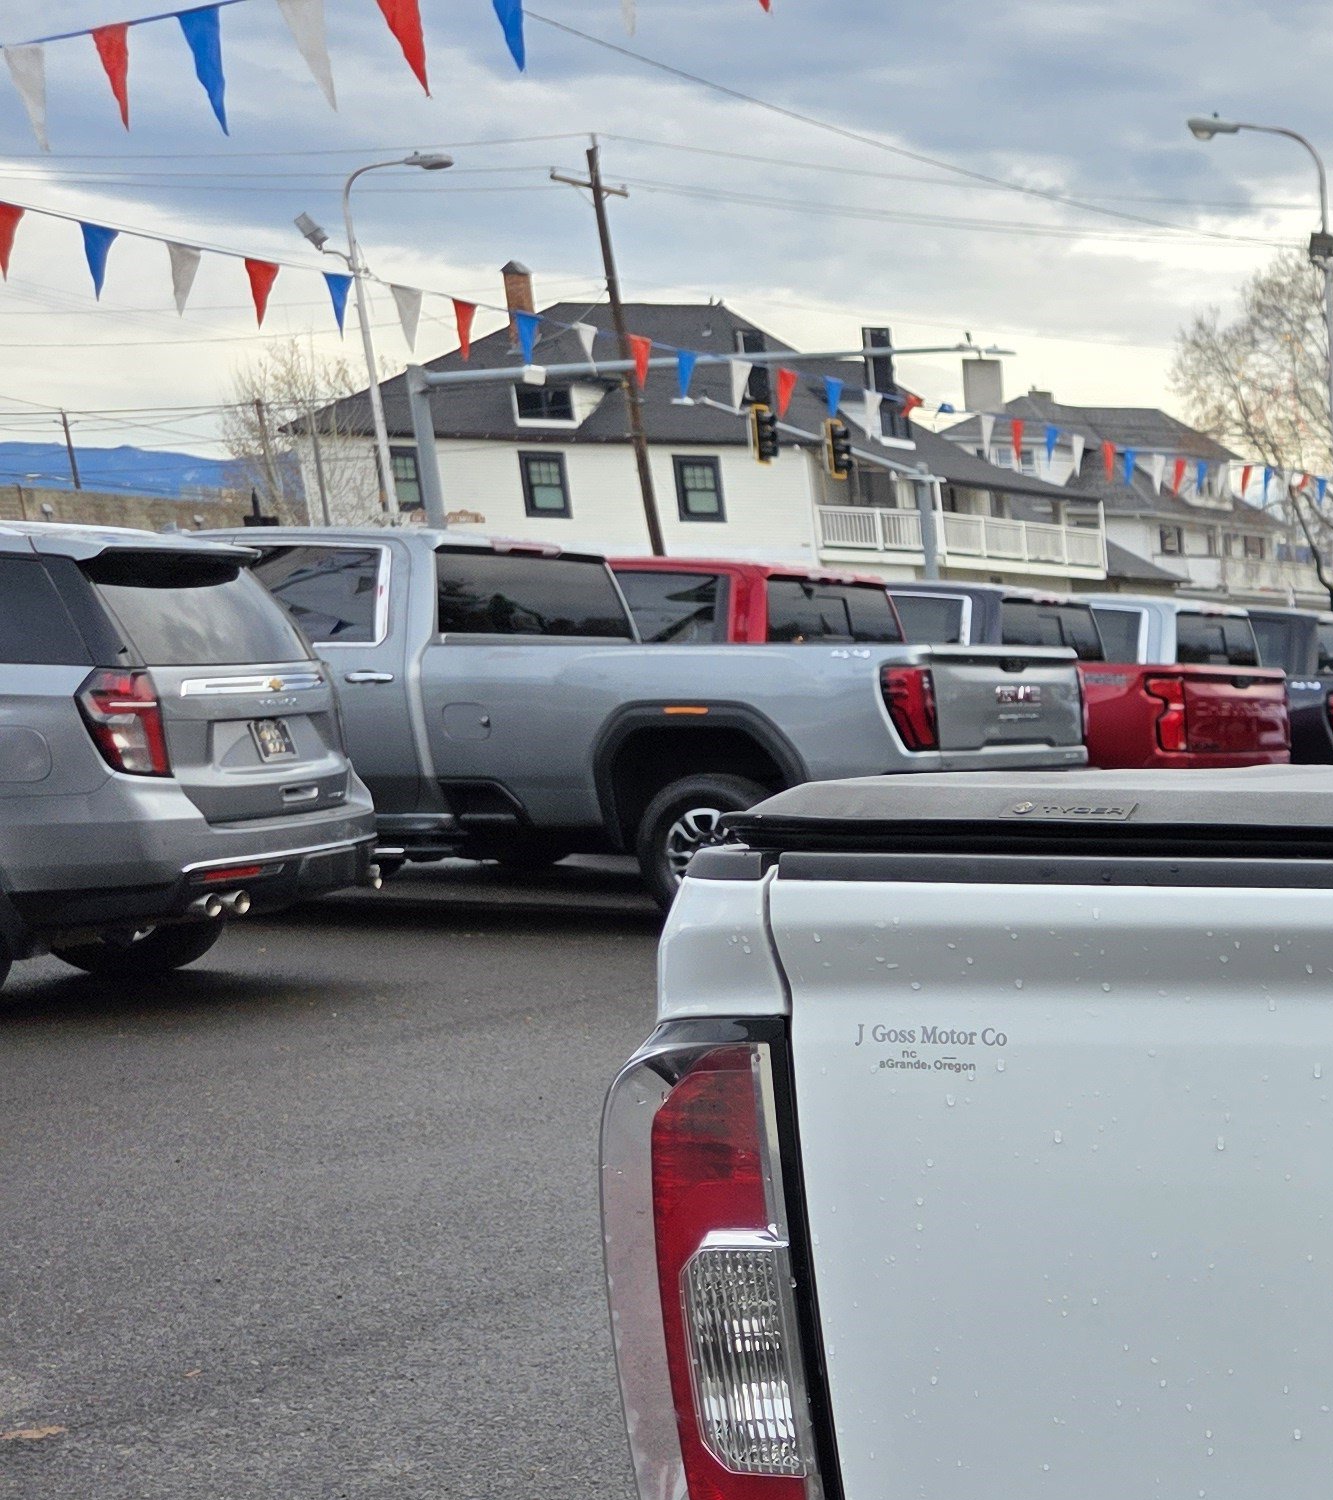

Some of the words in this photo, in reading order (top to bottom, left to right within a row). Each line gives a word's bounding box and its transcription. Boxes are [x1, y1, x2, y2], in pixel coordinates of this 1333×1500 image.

[854, 1023, 865, 1047] J
[871, 1024, 917, 1045] Goss
[920, 1026, 977, 1046] Motor
[981, 1027, 1008, 1047] Co
[934, 1059, 976, 1073] Oregon
